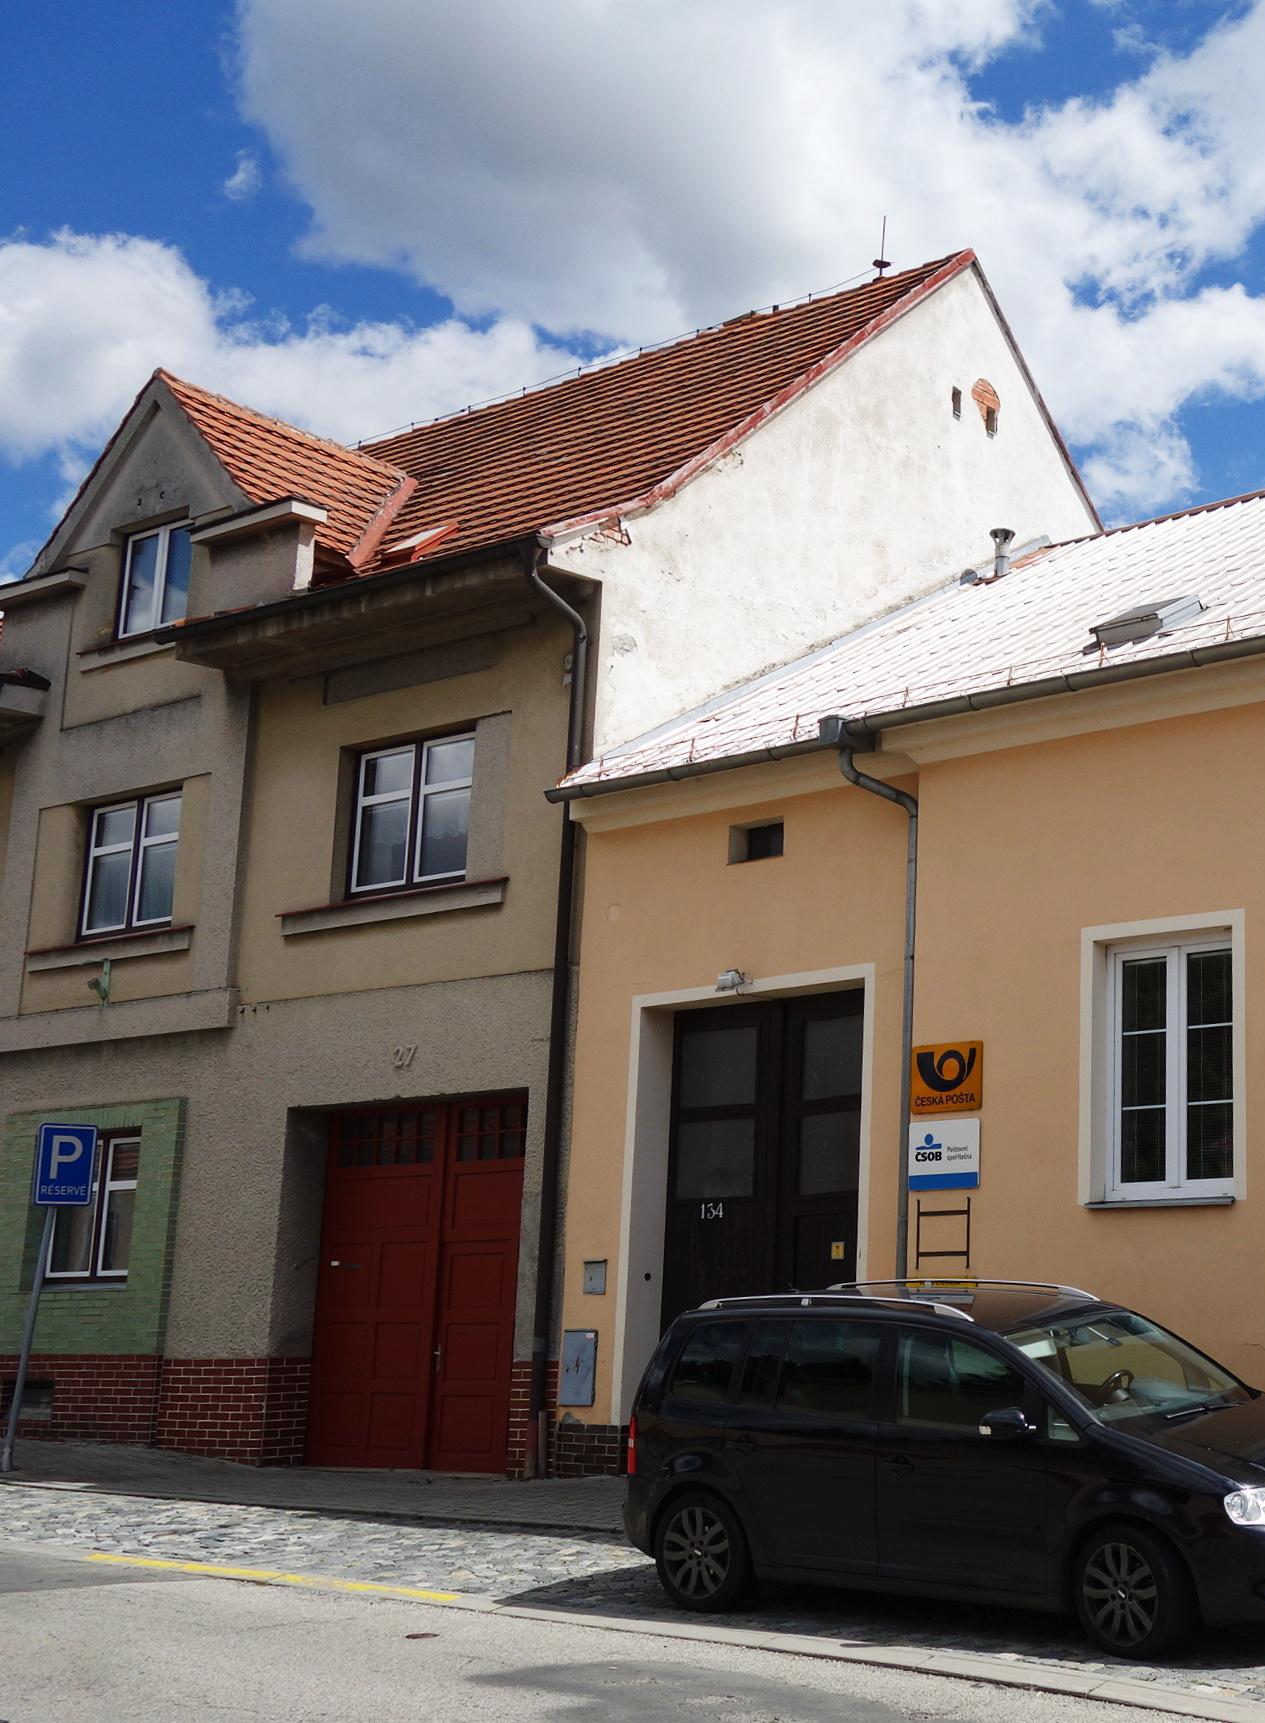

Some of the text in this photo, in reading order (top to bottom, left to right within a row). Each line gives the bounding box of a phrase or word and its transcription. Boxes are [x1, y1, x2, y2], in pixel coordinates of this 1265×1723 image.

[393, 1045, 418, 1069] 27
[945, 1092, 976, 1105] POŠTA
[49, 1135, 84, 1179] P
[914, 1151, 943, 1162] ČSOB
[40, 1184, 88, 1196] RÉSERVÉ
[701, 1202, 724, 1220] 134
